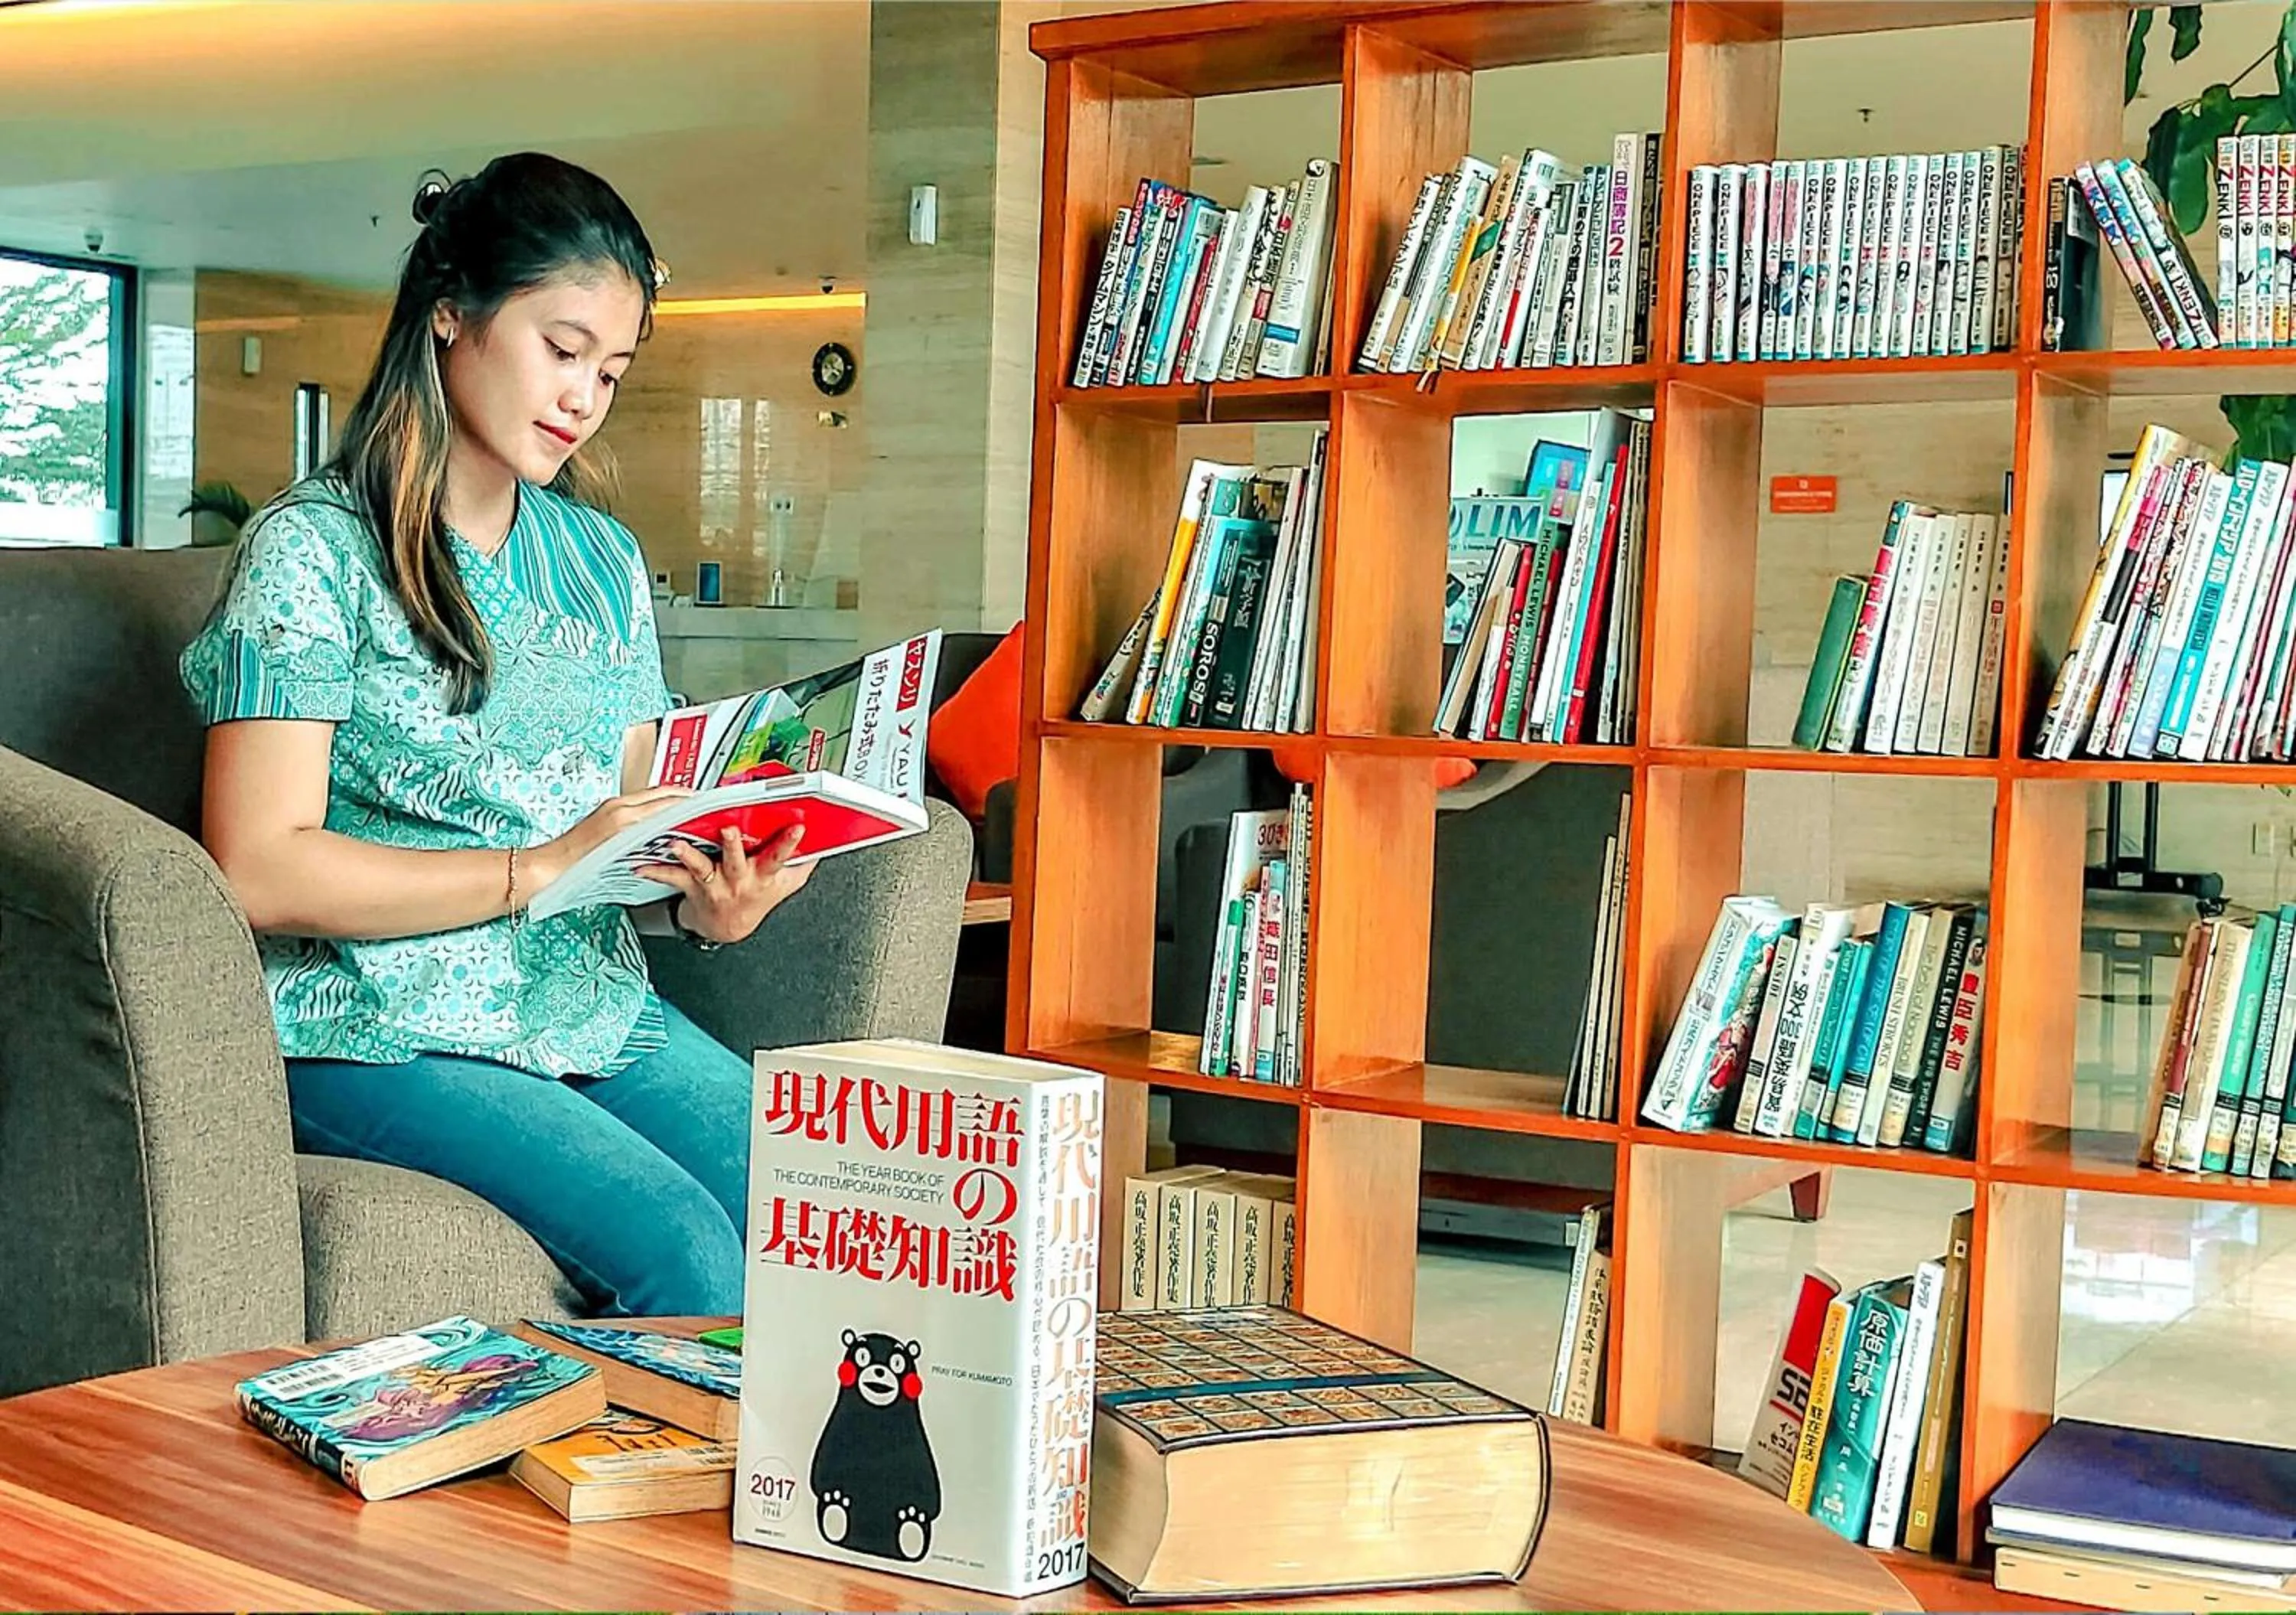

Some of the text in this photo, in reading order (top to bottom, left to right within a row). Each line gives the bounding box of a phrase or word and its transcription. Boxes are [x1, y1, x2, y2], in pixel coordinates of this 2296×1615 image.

[2218, 168, 2234, 219] ZENKI
[2238, 165, 2255, 216] ZENKI
[2258, 165, 2275, 216] ZENKI
[1533, 528, 1553, 586] MICHAEL
[1525, 587, 1541, 629] LEWIS
[1192, 621, 1219, 696] SOROS
[1505, 631, 1532, 713] MONEYBALL
[1945, 925, 1968, 984] MICHAEL
[1935, 986, 1957, 1029] LEWIS
[765, 1069, 1024, 1168] 現代用語
[774, 1168, 945, 1205] THE CONTEMPORARY SOCIETY
[837, 1160, 946, 1187] THE YEAR BOOK OF
[953, 1167, 1017, 1225] の
[760, 1197, 1017, 1302] 基礎知識
[1041, 1089, 1100, 1549] 現代用語の基礎知識
[951, 1368, 967, 1378] FOR
[1848, 1308, 1890, 1399] 原価計算
[751, 1473, 796, 1501] 2017
[1036, 1543, 1085, 1581] 2017
